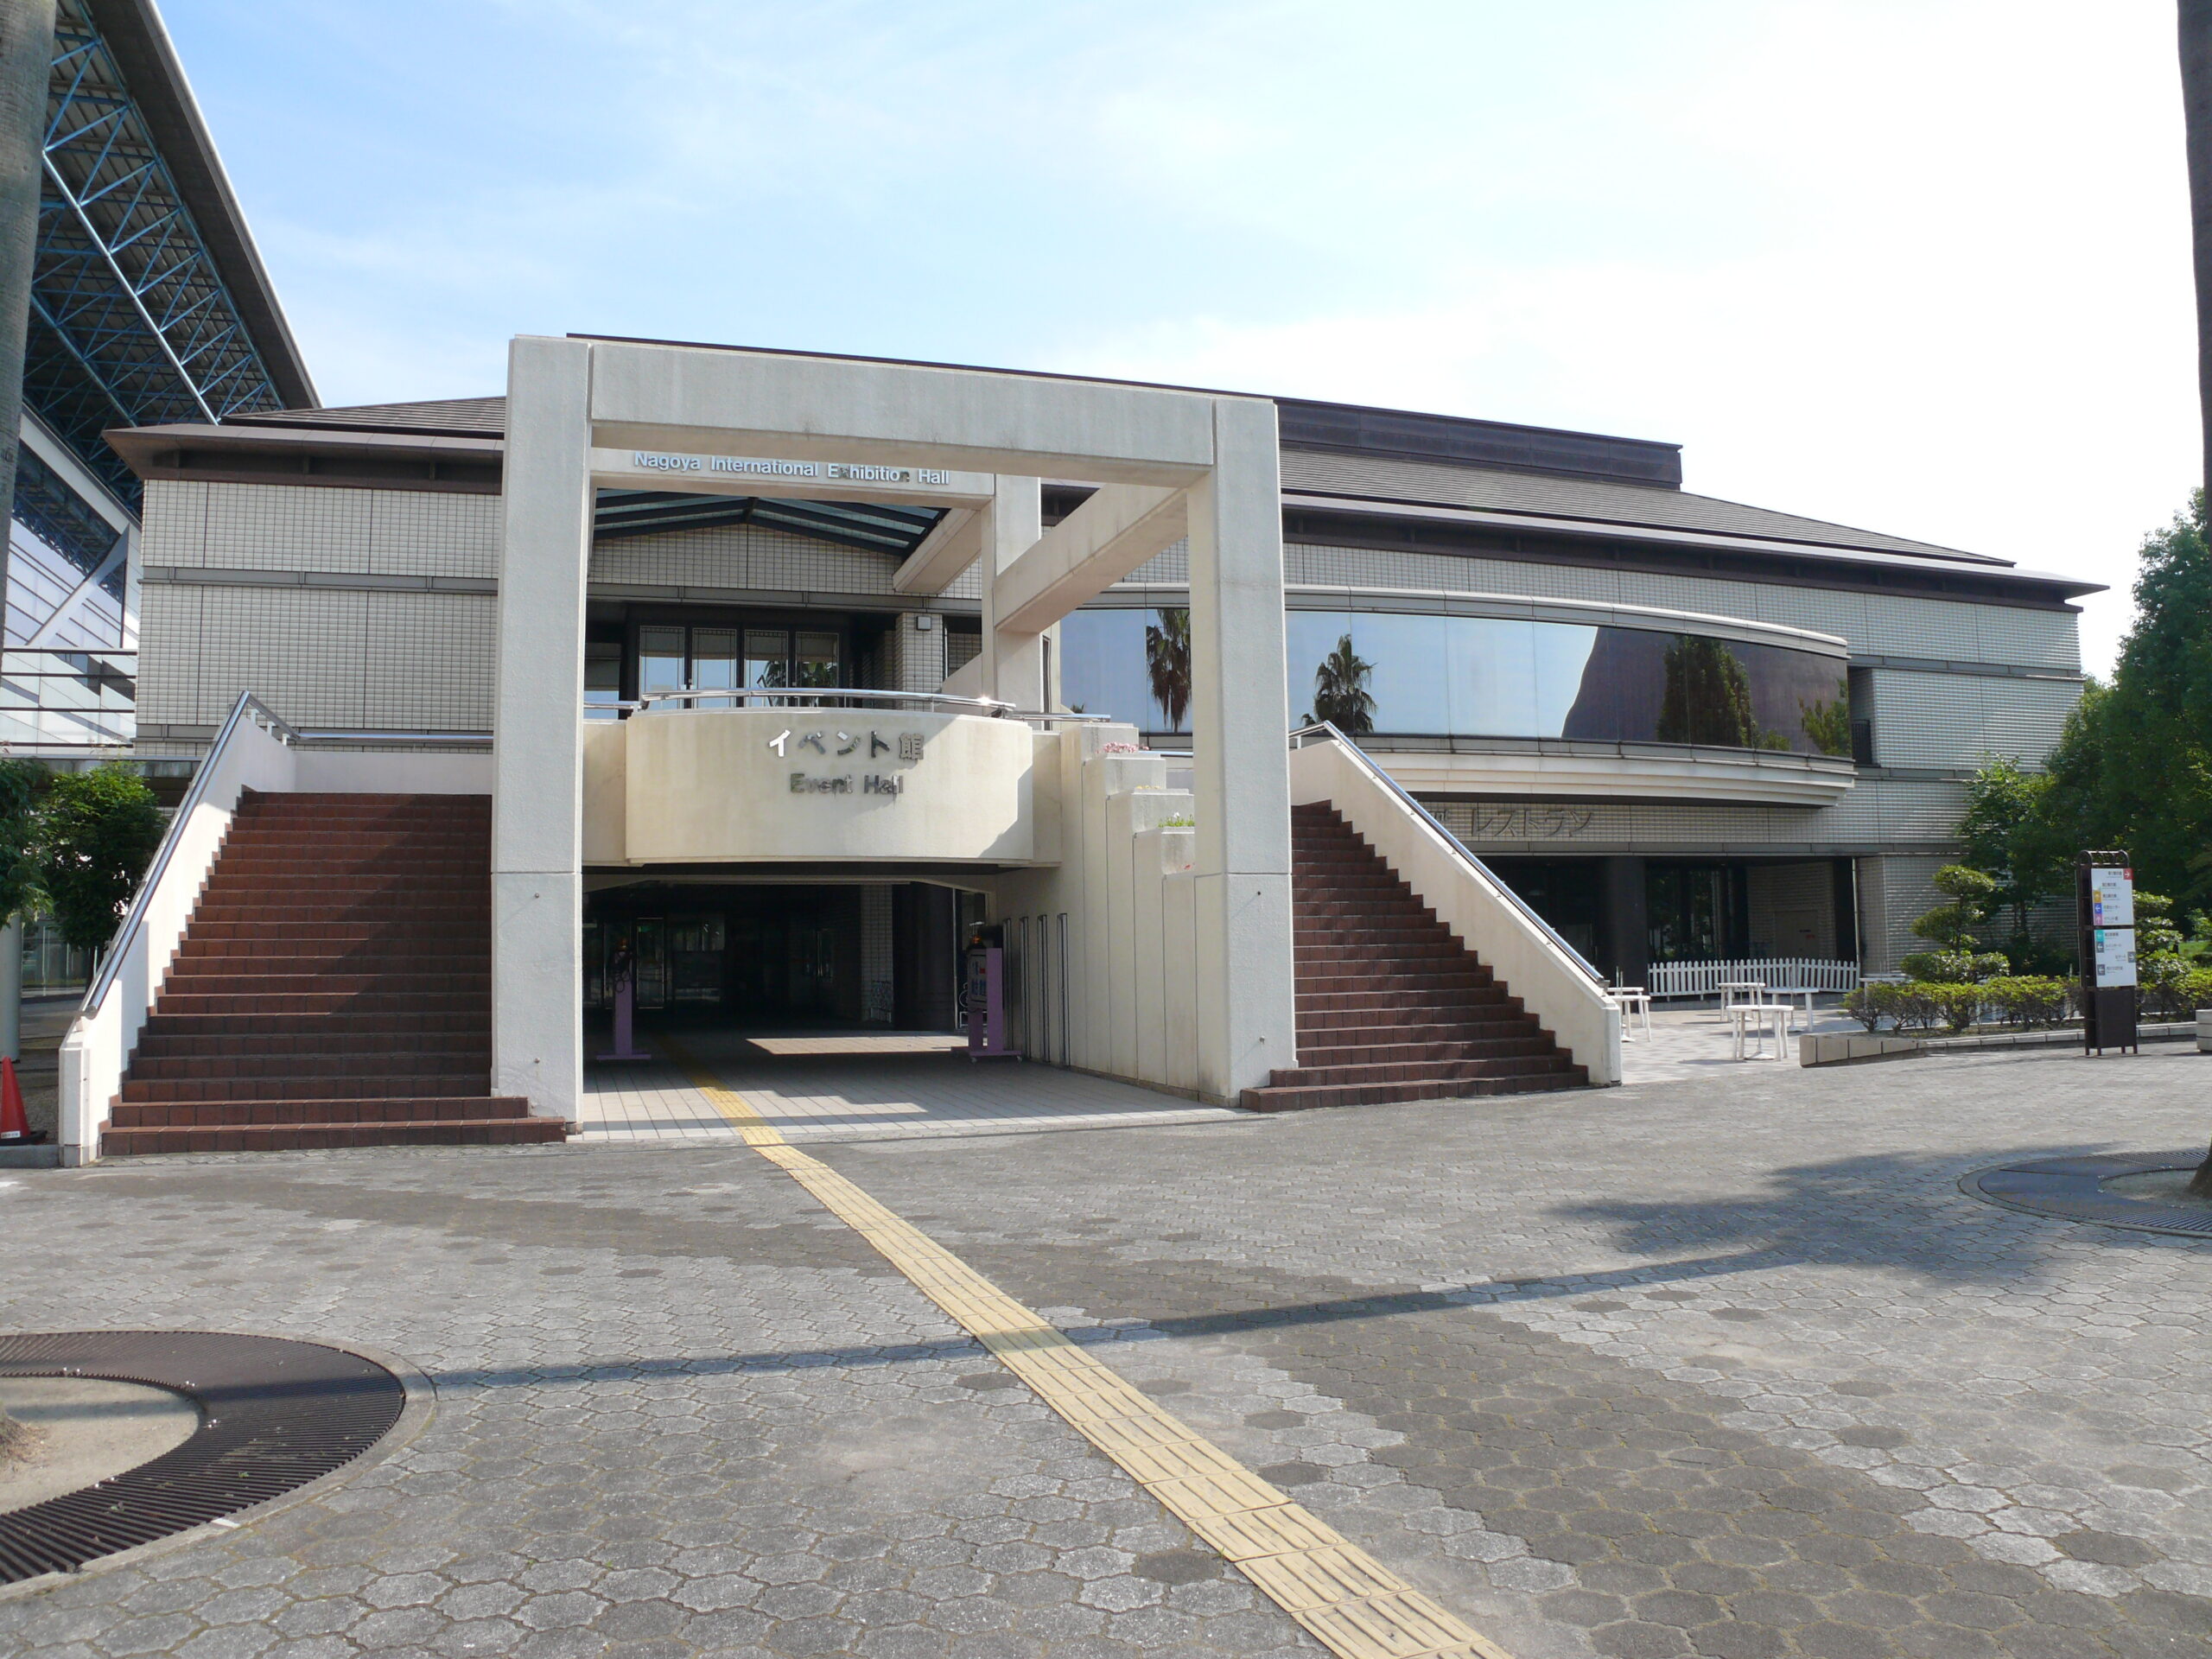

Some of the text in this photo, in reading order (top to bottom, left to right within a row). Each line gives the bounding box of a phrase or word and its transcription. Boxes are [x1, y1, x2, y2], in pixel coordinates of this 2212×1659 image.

[633, 451, 950, 485] Nagoya International Exhibition Hall
[767, 729, 924, 760] イベント館
[790, 773, 904, 794] Event Hall
[1471, 808, 1593, 837] レストラン
